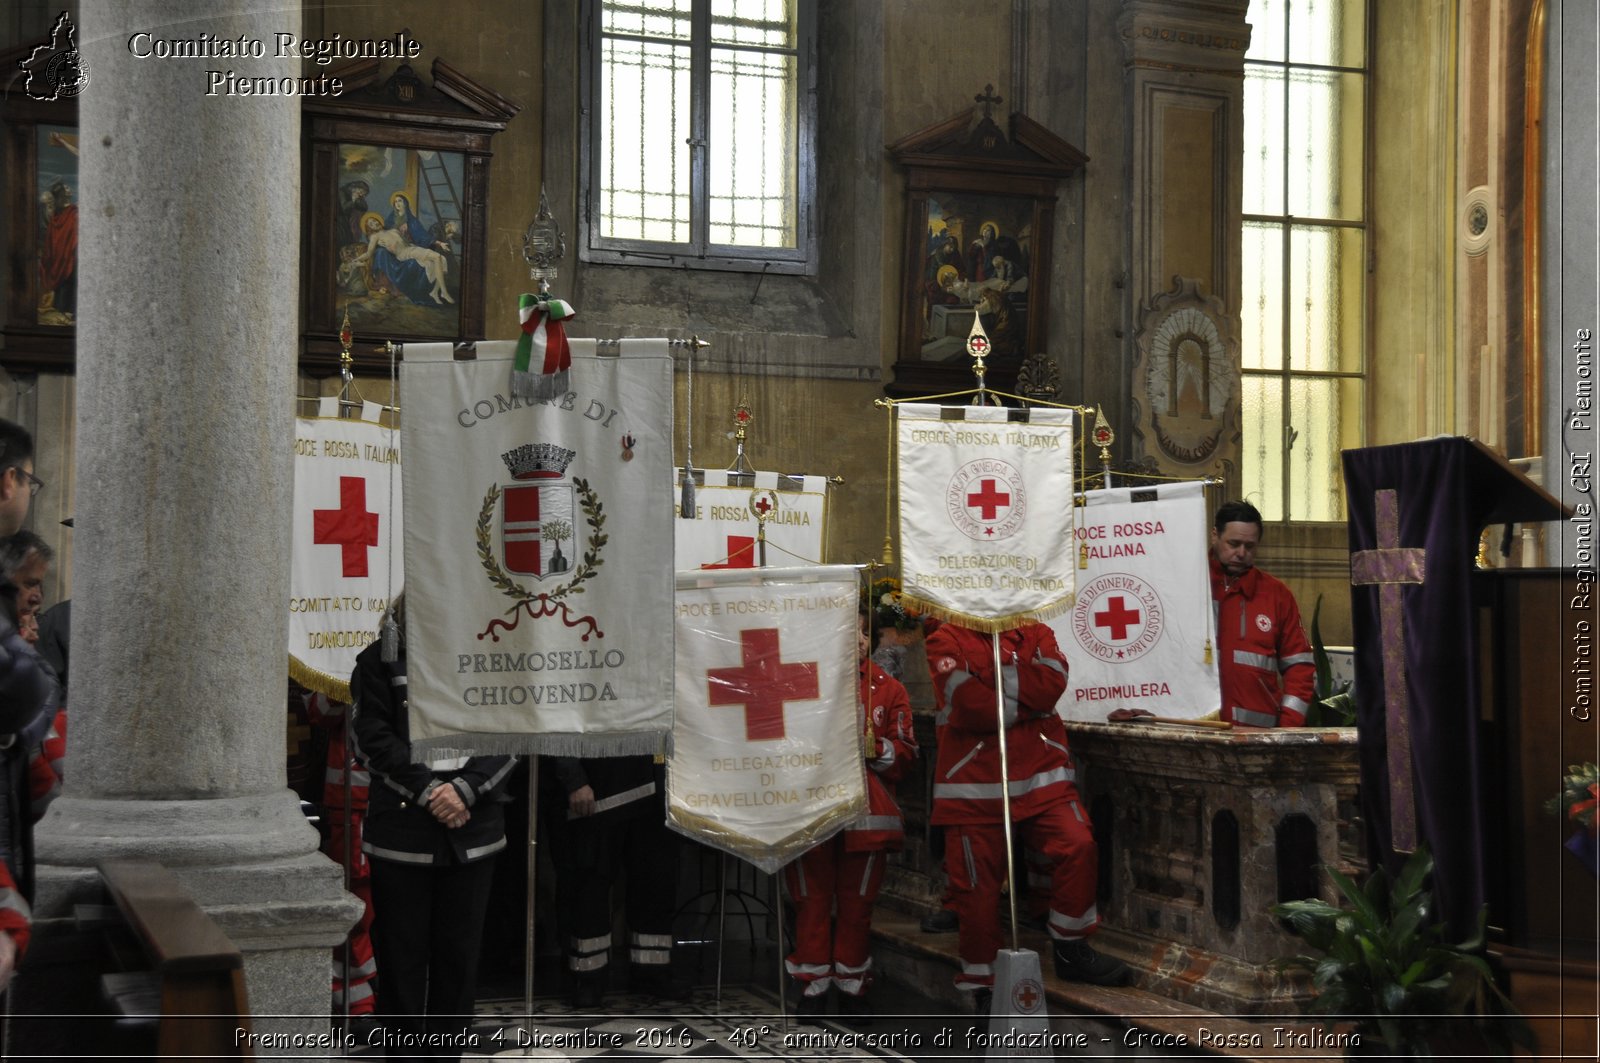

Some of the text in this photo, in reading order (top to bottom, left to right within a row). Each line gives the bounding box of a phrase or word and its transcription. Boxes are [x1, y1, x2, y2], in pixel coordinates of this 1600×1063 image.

[583, 399, 618, 428] DI
[911, 430, 1060, 449] CROCE ROSSA ITALIANA
[324, 440, 360, 459] ROSSA
[364, 443, 400, 465] ITALIAN
[711, 505, 750, 522] ROSSA
[1113, 521, 1165, 538] ROSSA
[938, 555, 1038, 571] DELEGAZIONE DI
[916, 573, 1065, 592] PREMOSELLO CHIOVENDA
[289, 596, 362, 613] COMITATO
[726, 599, 777, 615] ROSSA
[783, 597, 850, 612] ITALIANA
[1075, 577, 1160, 658] CONVENZIONE DI GINEVRA 22 AGOSTO 1864
[457, 649, 625, 673] PREMOSELLO
[463, 682, 618, 706] CHIOVENDA
[1075, 682, 1171, 702] PIEDIMULERA
[711, 752, 824, 772] DELEGAZIONE
[760, 773, 775, 787] DI
[685, 783, 849, 808] GRAVELLONA TOCE
